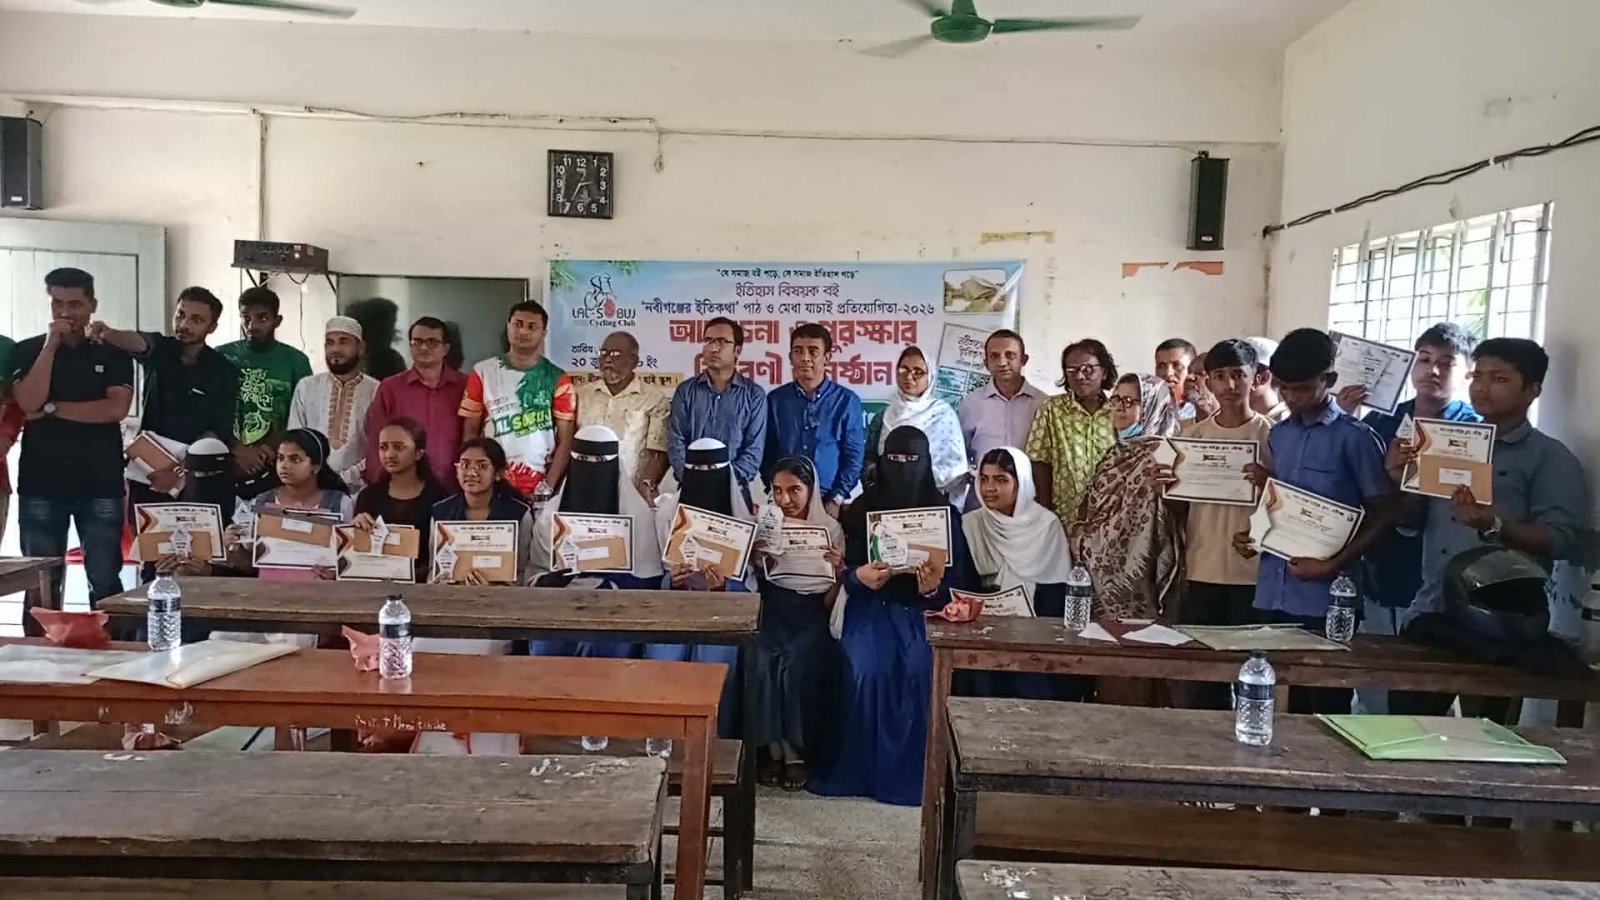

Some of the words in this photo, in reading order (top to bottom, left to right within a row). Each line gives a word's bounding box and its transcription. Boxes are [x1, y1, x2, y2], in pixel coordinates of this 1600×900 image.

[563, 158, 572, 166] 11
[576, 158, 587, 167] 12
[555, 165, 565, 175] 10
[600, 167, 607, 177] 2
[556, 179, 563, 188] 9
[600, 181, 606, 190] 3
[556, 193, 563, 202] 8
[599, 196, 606, 204] 4
[563, 202, 571, 214] 7
[577, 203, 584, 213] 6
[591, 203, 598, 213] 5
[735, 281, 775, 298] ইতিহাস
[778, 281, 820, 298] বিষয়ক
[823, 283, 840, 298] বই
[743, 299, 762, 314] পাঠ
[766, 303, 774, 314] ও
[778, 303, 801, 314] মেধা
[805, 301, 833, 314] যাচাই
[589, 319, 617, 328] Cycling
[618, 319, 636, 327] Club
[571, 358, 587, 367] ২০
